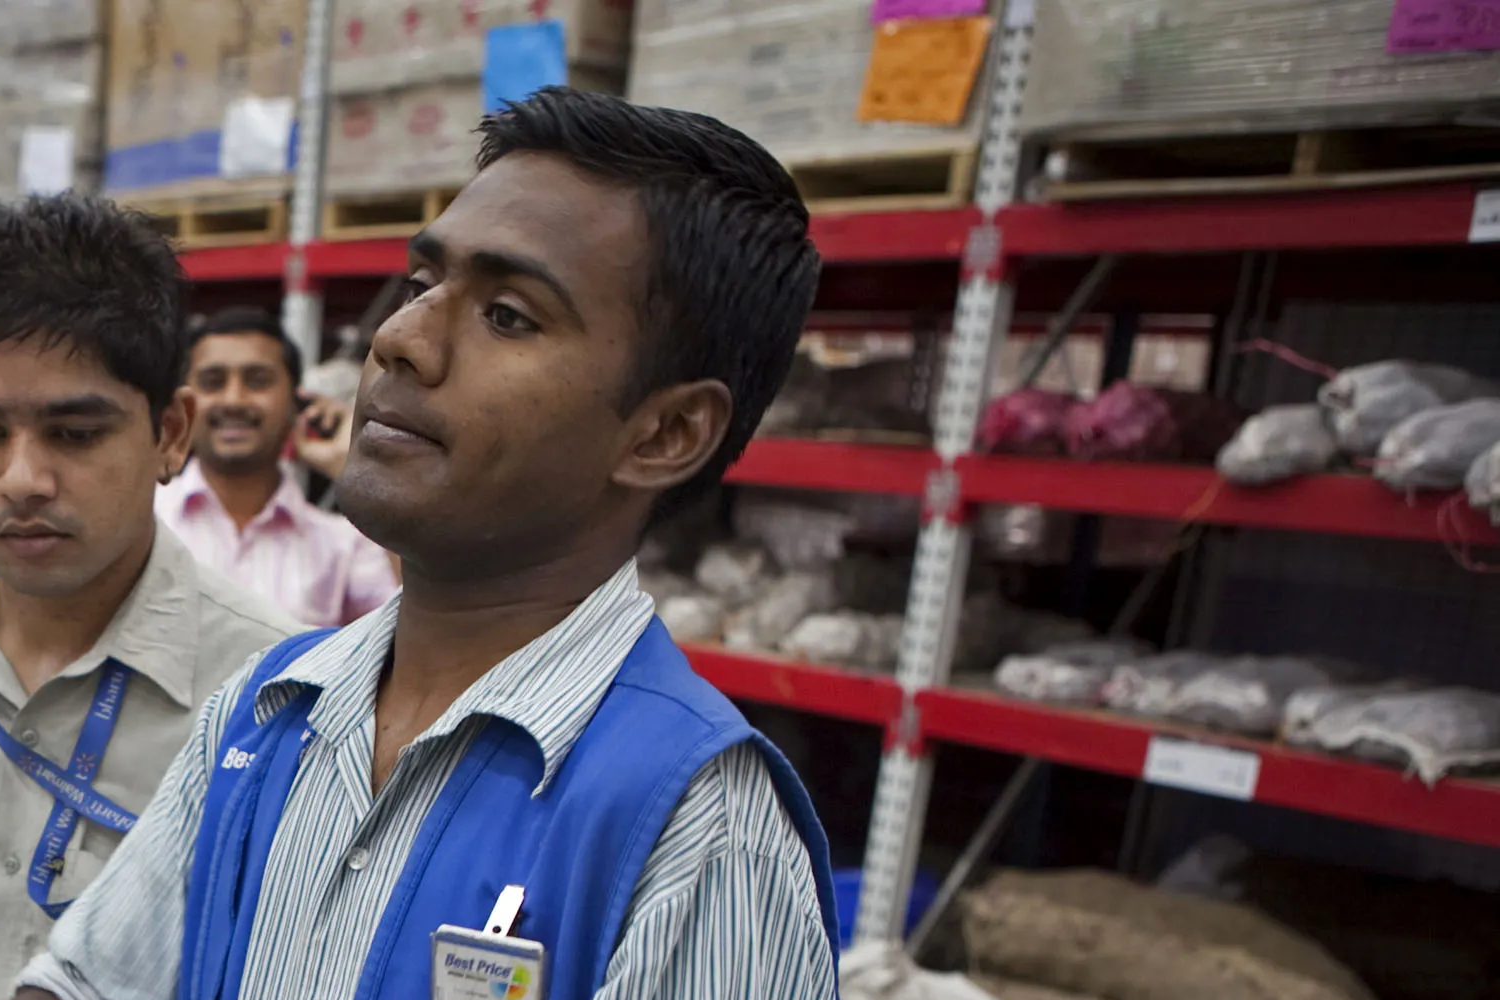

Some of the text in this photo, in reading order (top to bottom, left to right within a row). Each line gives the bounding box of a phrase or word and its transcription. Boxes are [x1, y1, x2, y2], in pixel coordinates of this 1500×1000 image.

[34, 763, 86, 805] Walmart
[444, 952, 475, 971] Best
[476, 960, 513, 979] Price
